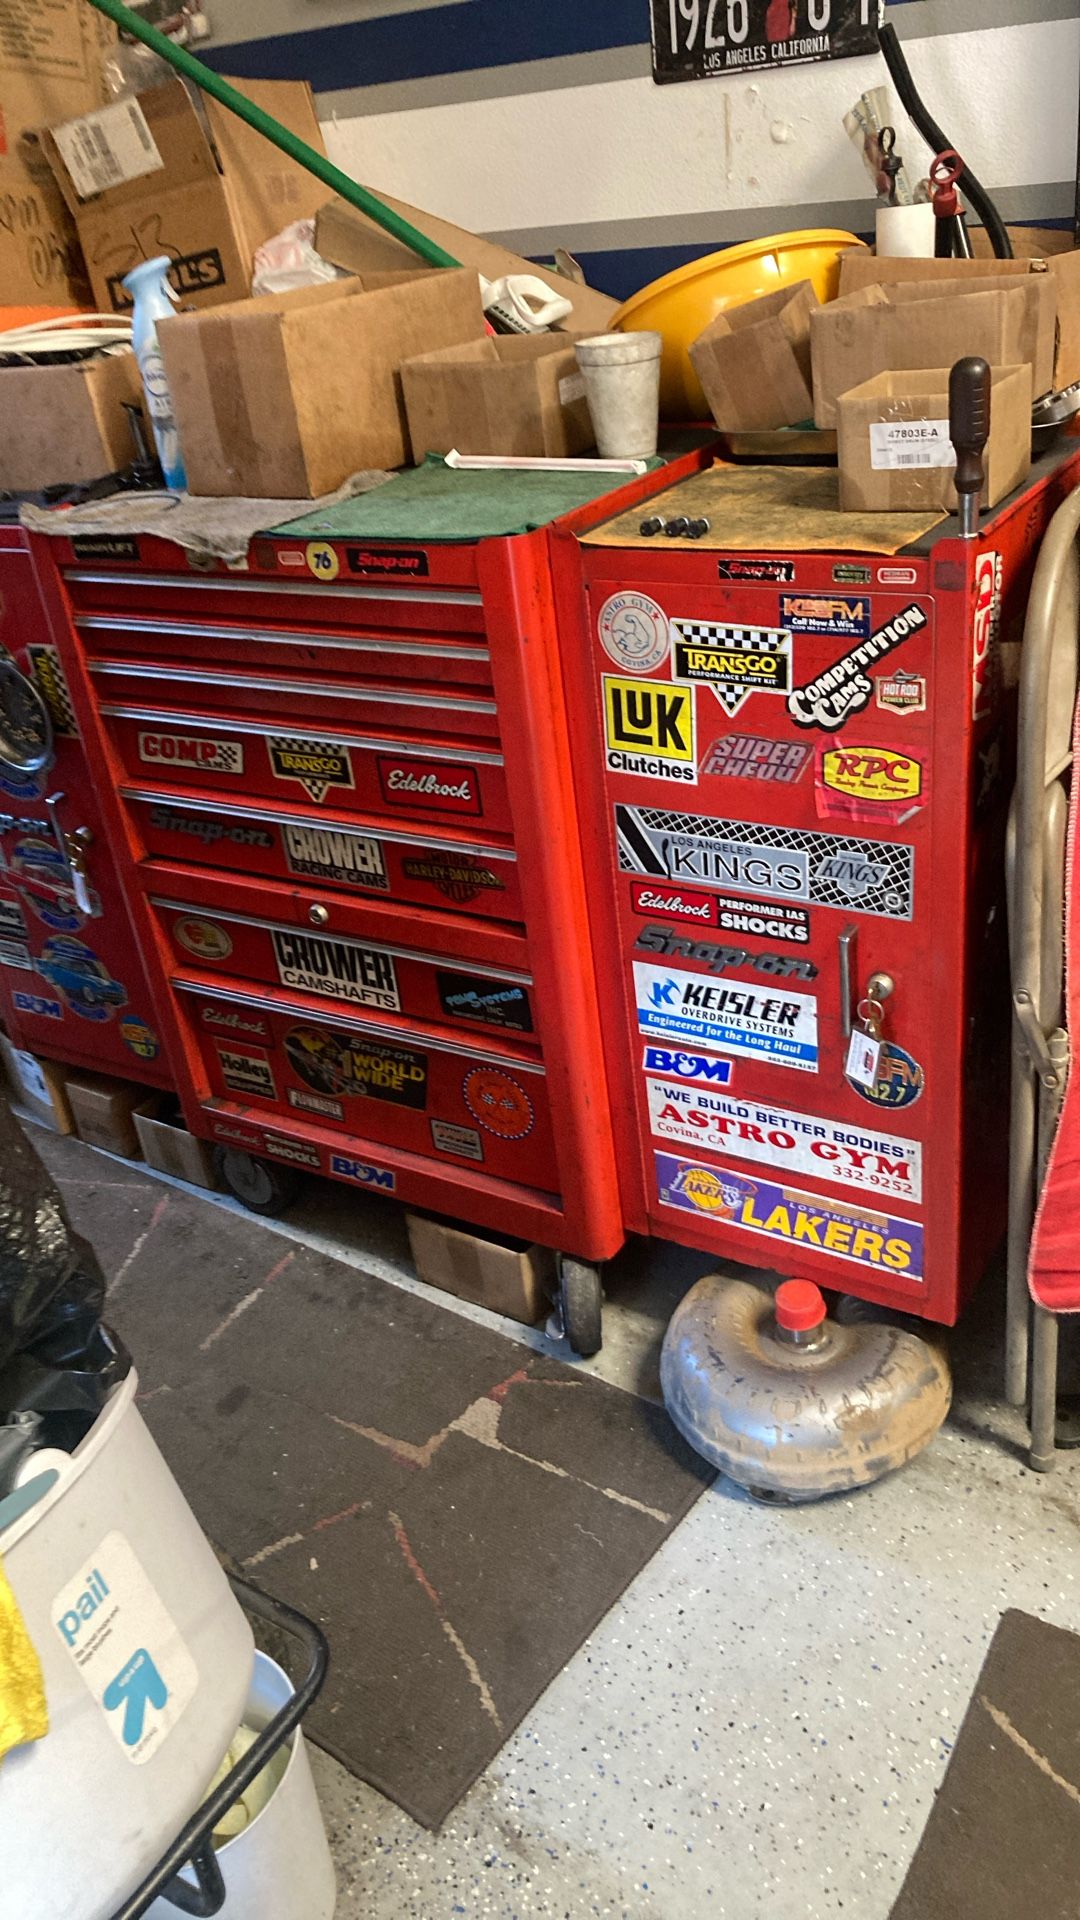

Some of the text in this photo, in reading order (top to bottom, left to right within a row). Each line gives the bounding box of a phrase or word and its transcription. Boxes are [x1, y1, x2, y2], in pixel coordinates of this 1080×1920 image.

[702, 34, 831, 70] LOS ANGELES CALIFORNIA
[888, 428, 939, 439] 47803E-A
[313, 551, 332, 569] 76
[357, 553, 420, 570] Snap-on
[604, 598, 654, 622] ASTRO GYM
[792, 618, 808, 626] Call
[809, 618, 827, 627] Now
[837, 620, 854, 628] Win
[652, 650, 662, 660] CA
[682, 647, 777, 676] TRANSGO
[788, 606, 926, 723] COMPETITION
[687, 670, 740, 681] PERFORMANCE
[741, 675, 762, 683] SHIFT
[883, 683, 919, 696] HOT ROD
[812, 672, 873, 727] CAMS
[142, 735, 218, 762] COMP
[277, 751, 342, 774] TRANSGO
[714, 735, 806, 768] SUPER
[196, 759, 234, 771] CAMS
[608, 752, 694, 781] Clutches
[834, 753, 910, 783] RPC
[387, 769, 472, 801] Edelbrock
[151, 807, 274, 847] Snap-on
[287, 825, 384, 876] CROWER
[671, 835, 752, 857] LOS ANGELES
[292, 862, 388, 889] RACING CAMS
[673, 847, 802, 891] KINGS
[821, 859, 885, 885] KINGS
[637, 890, 712, 919] Edelbrock
[719, 898, 806, 921] PERFORMER IAS
[720, 912, 809, 942] SHOCKS
[273, 931, 396, 993] CROWER
[634, 924, 819, 983] Snap-on
[283, 970, 398, 1009] CAMSHAFTS
[681, 982, 801, 1027] KEISLER
[15, 993, 61, 1018] B&M
[647, 1013, 801, 1055] Engineered for the Long Haul
[681, 1006, 795, 1039] OVERDRIVE SYSTEMS
[349, 1038, 416, 1063] Snap-on
[644, 1047, 731, 1084] B&M
[218, 1053, 271, 1084] Holley
[352, 1052, 426, 1083] WORLD
[352, 1066, 405, 1092] WIDE
[657, 1121, 727, 1147] Covina, CA
[697, 1095, 749, 1118] BUILD
[755, 1111, 827, 1138] BETTER
[832, 1130, 916, 1158] BODIES"
[265, 1142, 322, 1168] SHOCKS
[656, 1103, 911, 1181] ASTRO GYM
[331, 1155, 395, 1190] B&M
[832, 1164, 914, 1195] 332-9252
[668, 1171, 743, 1210] LAKERS
[741, 1195, 913, 1270] LAKERS
[788, 1201, 891, 1236] LOS ANGELES
[56, 1567, 111, 1648] pail
